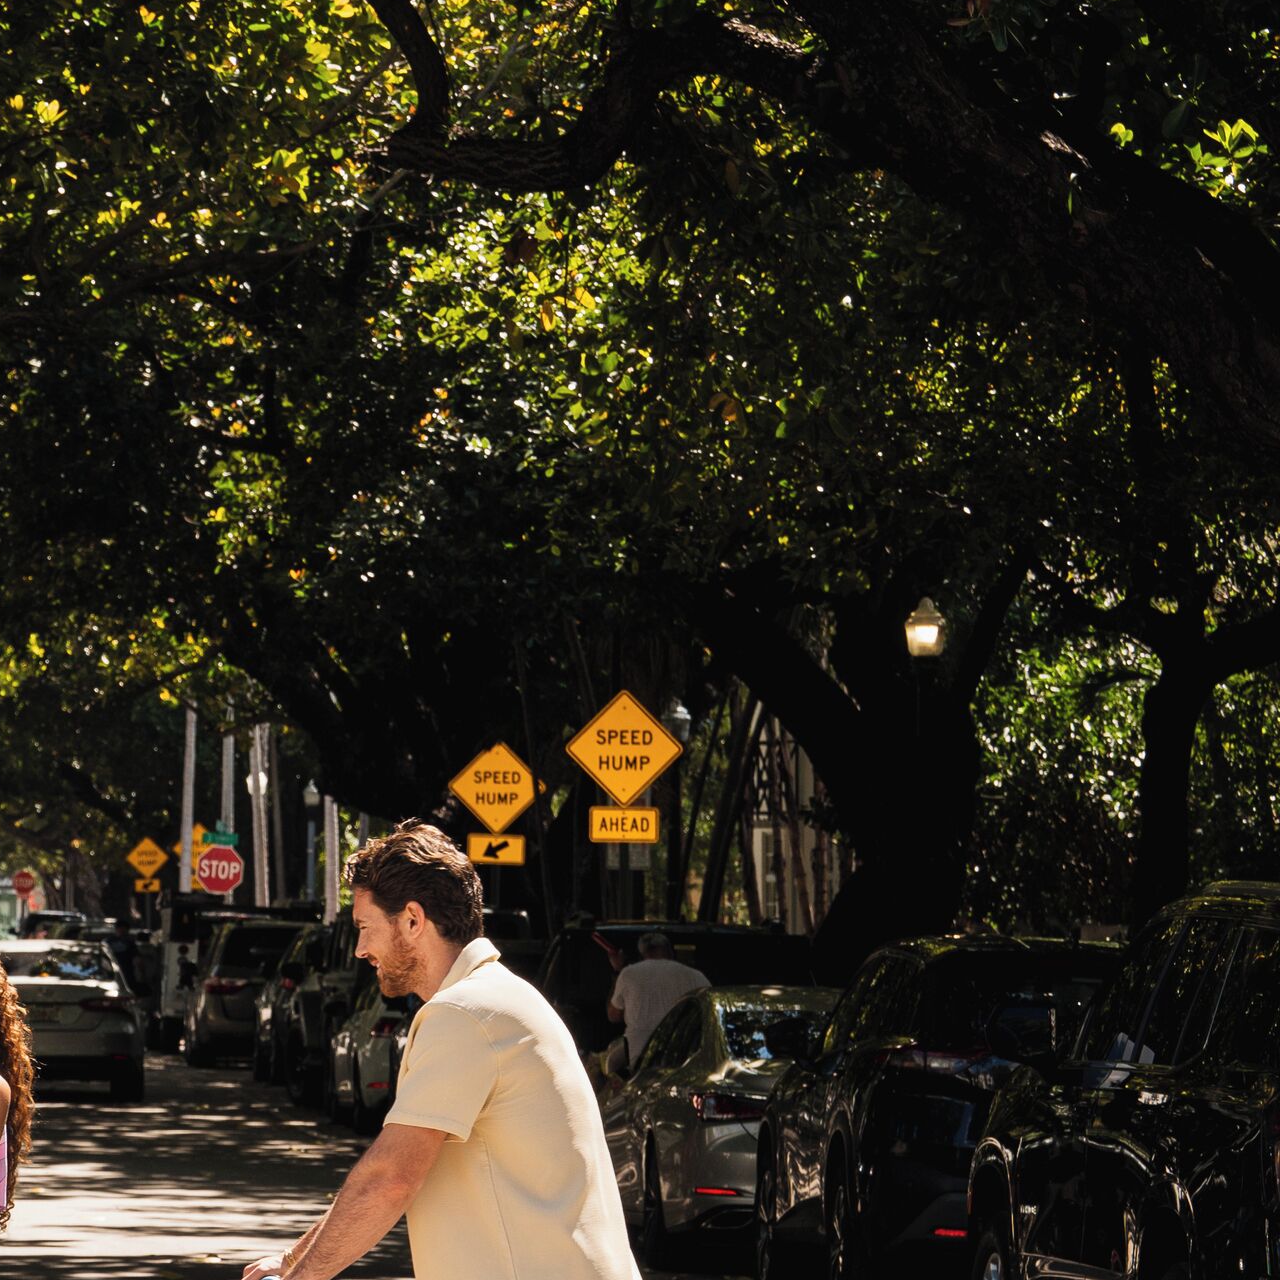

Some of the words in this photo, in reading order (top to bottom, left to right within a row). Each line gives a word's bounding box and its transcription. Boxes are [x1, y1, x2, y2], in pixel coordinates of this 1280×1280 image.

[596, 729, 653, 746] SPEED
[598, 755, 651, 771] HUMP
[473, 771, 521, 784] SPEED
[475, 792, 519, 806] HUMP
[599, 816, 650, 833] AHEAD
[199, 860, 240, 880] STOP
